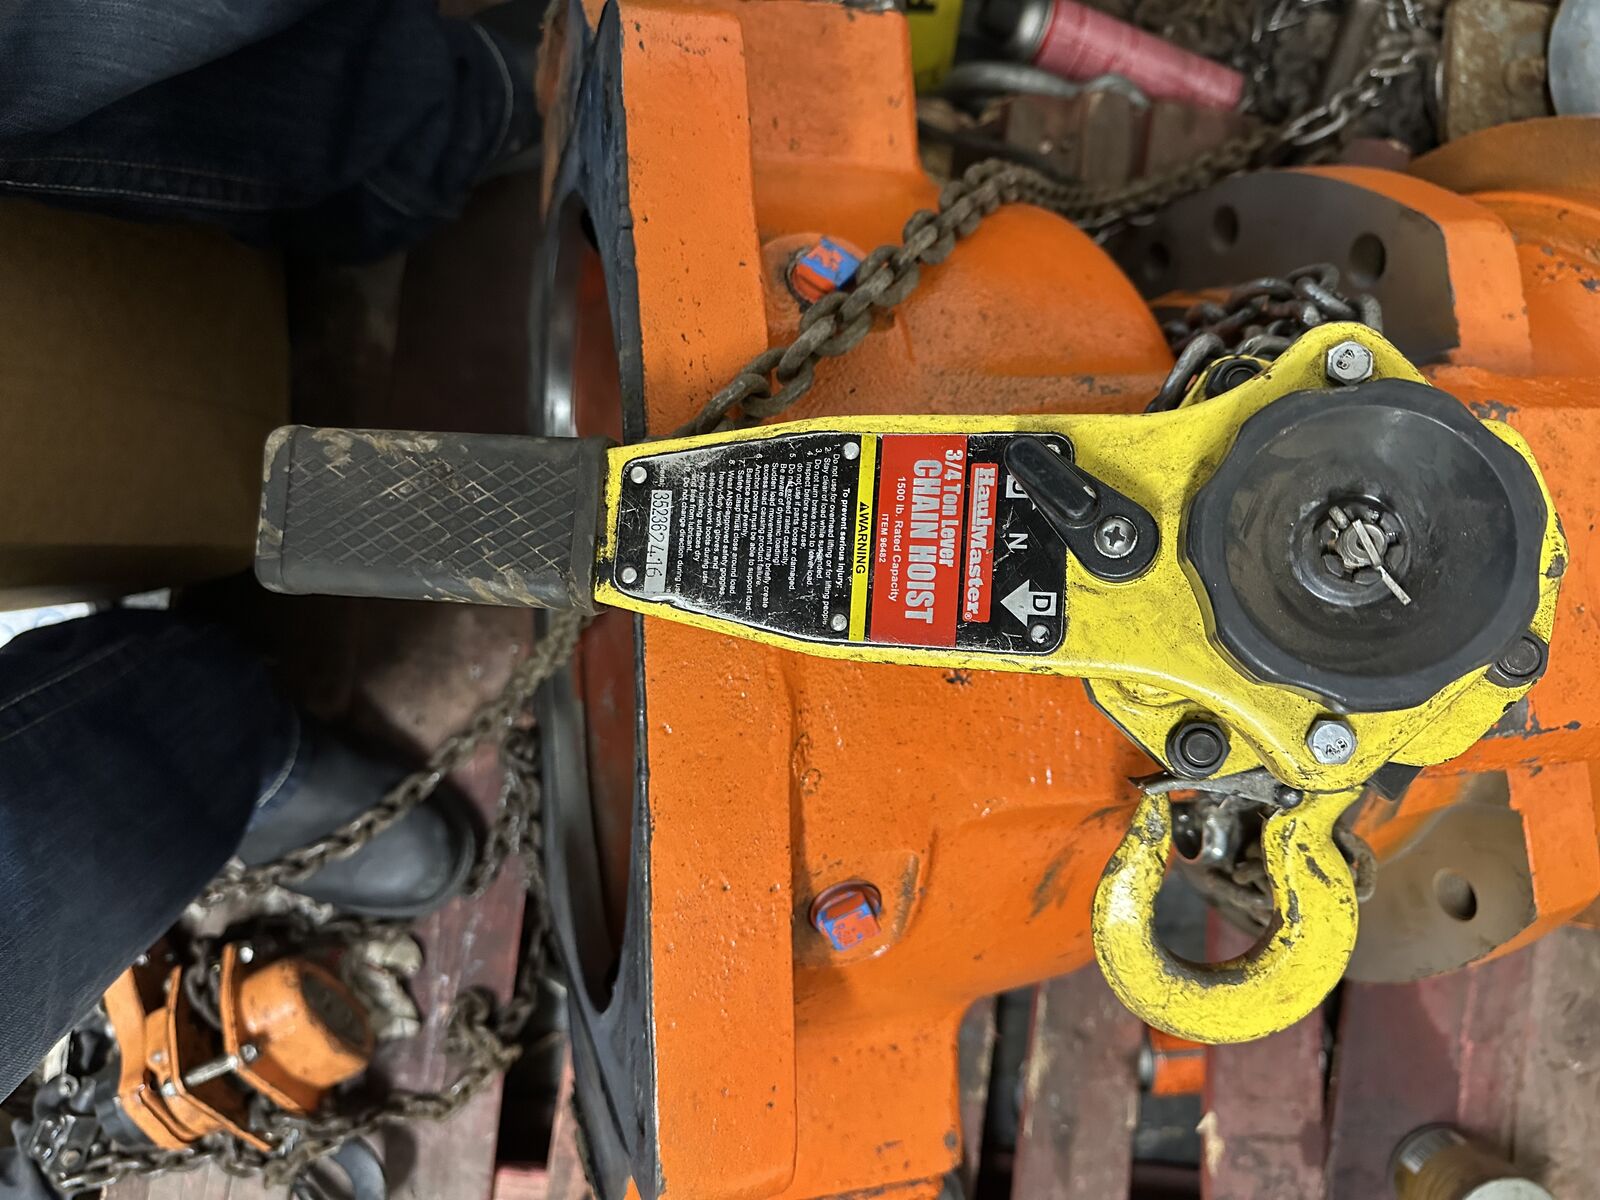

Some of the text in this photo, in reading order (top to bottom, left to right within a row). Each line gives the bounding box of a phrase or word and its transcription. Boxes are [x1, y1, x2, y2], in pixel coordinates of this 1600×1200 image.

[779, 463, 786, 473] Be
[787, 463, 794, 474] Do
[796, 463, 803, 472] do
[814, 459, 821, 469] Do
[821, 457, 830, 472] Stay
[832, 453, 839, 464] Do
[682, 477, 690, 487] Do
[726, 470, 734, 488] Wear
[735, 469, 744, 491] Safety
[744, 468, 752, 495] Balance
[753, 463, 761, 489] Anchor
[770, 462, 778, 489] Sudden
[803, 461, 812, 487] Inspect
[715, 471, 725, 509] heavy-duty
[751, 491, 759, 511] points
[785, 488, 793, 513] exceed
[802, 488, 810, 511] before
[829, 493, 837, 503] for
[842, 488, 849, 497] To
[678, 501, 688, 527] change
[734, 493, 742, 512] clasp
[839, 499, 848, 529] prevent
[938, 449, 963, 567] 3/4 Ton Lever
[692, 472, 706, 561] Keep braking surfaces dry
[757, 506, 766, 533] causing
[766, 508, 774, 545] movement
[774, 506, 783, 536] dynamic
[783, 515, 791, 533] rated
[791, 507, 799, 525] parts
[827, 504, 836, 537] overhead
[685, 521, 694, 552] lubricant.
[749, 531, 756, 540] be
[809, 521, 817, 538] knob
[818, 519, 826, 538] while
[878, 513, 888, 562] ITEM 96482
[887, 476, 906, 601] 1500 lb. Rated Capacity
[904, 458, 942, 623] CHAIN HOIST
[677, 528, 685, 558] direction
[712, 529, 721, 553] gloves,
[748, 542, 756, 557] able
[755, 535, 765, 562] product
[771, 537, 781, 565] loading!
[825, 539, 833, 558] lifting
[838, 531, 846, 560] serious
[855, 512, 869, 573] WARNING
[701, 546, 710, 568] during
[720, 544, 729, 565] safety
[730, 552, 738, 576] around
[674, 559, 683, 581] during
[745, 567, 754, 593] support
[755, 564, 763, 587] failure.
[762, 562, 771, 584] briefly
[787, 556, 796, 591] damaged.
[1008, 532, 1027, 548] N
[1032, 595, 1052, 612] D
[822, 580, 830, 599] lifting
